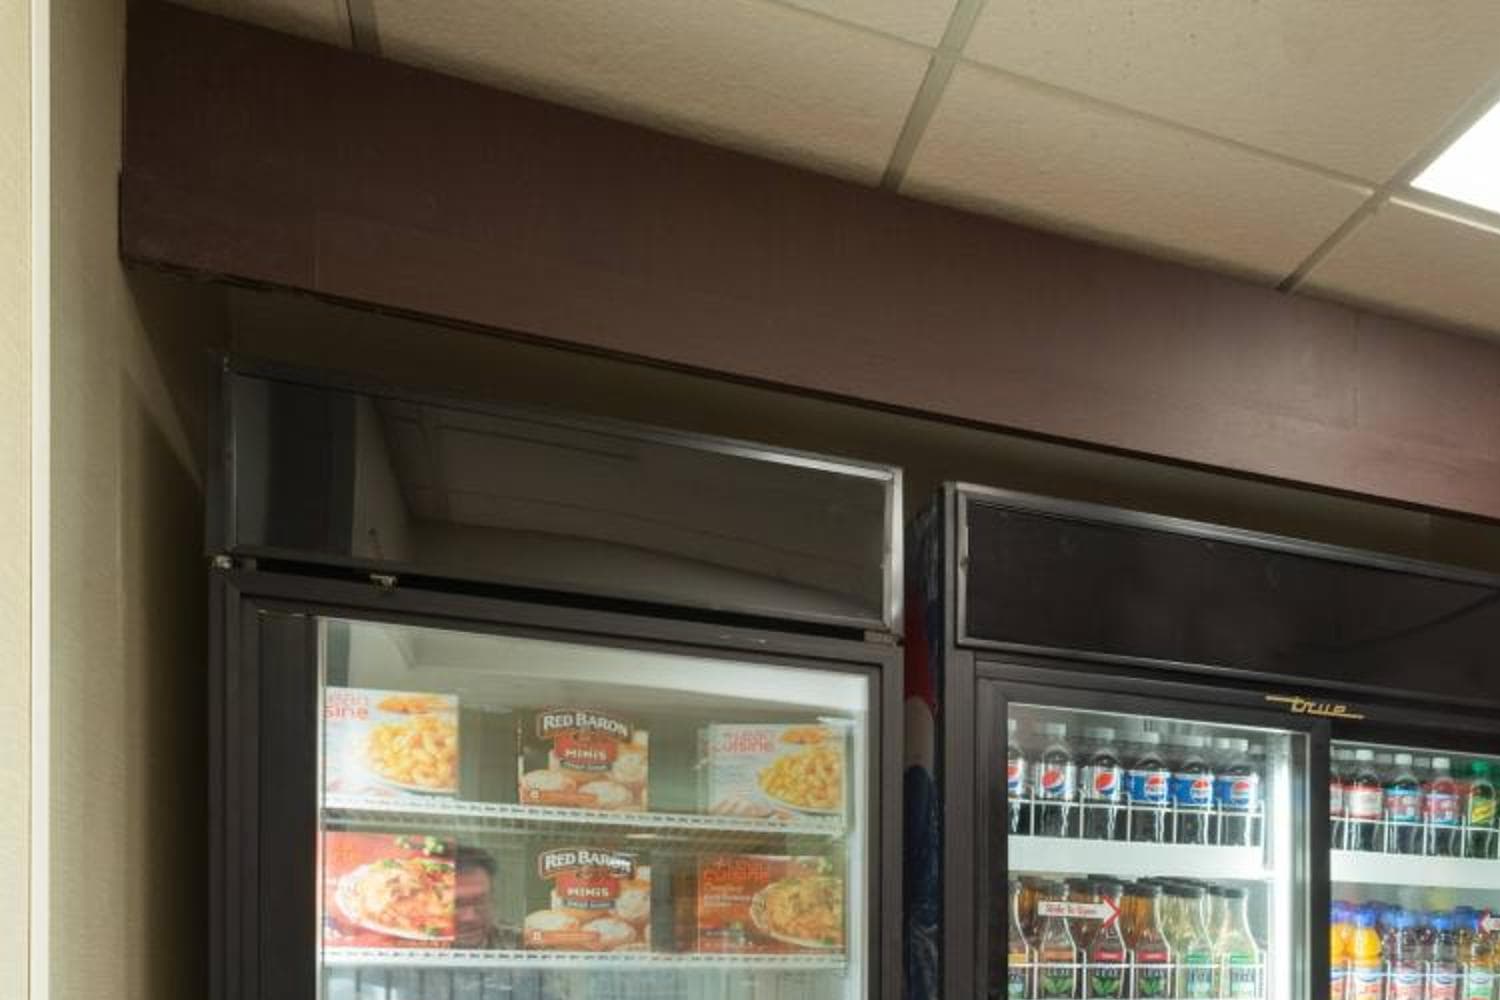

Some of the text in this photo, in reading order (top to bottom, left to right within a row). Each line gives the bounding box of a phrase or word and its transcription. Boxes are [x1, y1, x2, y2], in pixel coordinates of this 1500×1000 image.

[544, 713, 628, 737] RED BARON
[545, 853, 575, 870] RED
